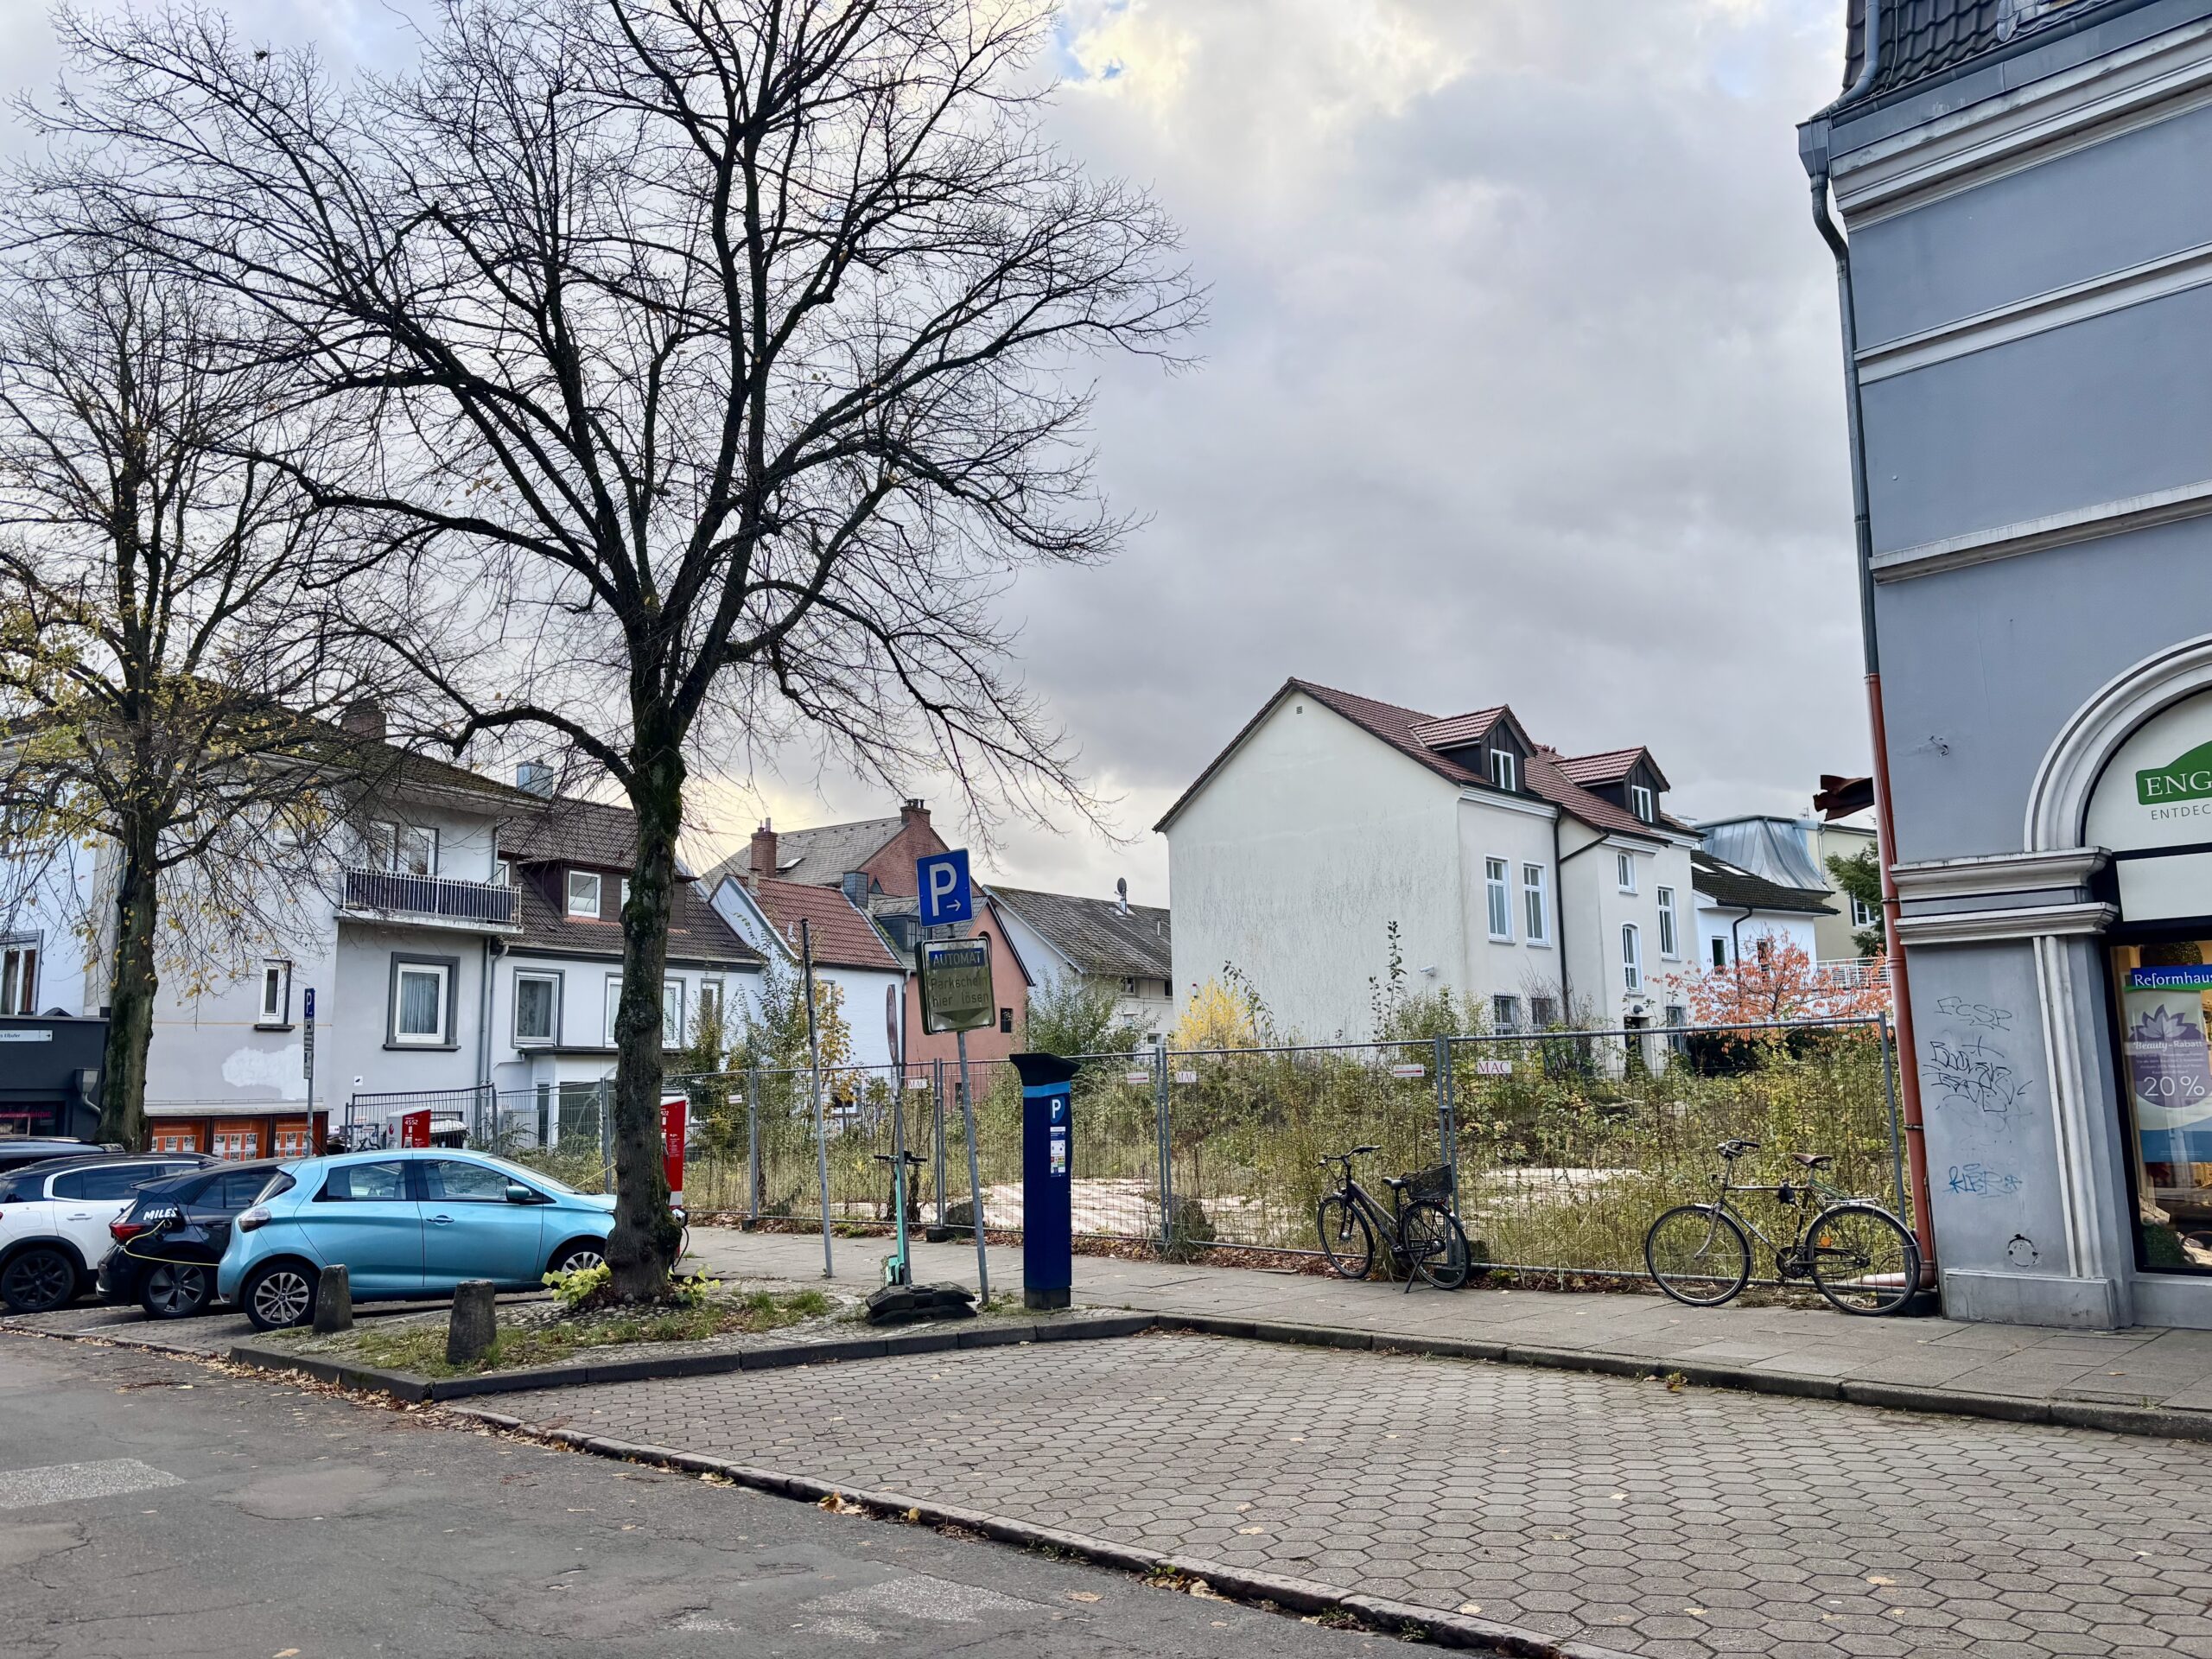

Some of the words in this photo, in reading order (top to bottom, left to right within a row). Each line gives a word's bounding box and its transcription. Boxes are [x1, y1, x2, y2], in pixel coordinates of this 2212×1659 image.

[2152, 804, 2211, 820] ENTDEC
[930, 862, 957, 917] P
[933, 950, 982, 968] AUTOMAT
[931, 976, 988, 990] Parkschein
[932, 995, 953, 1007] hier
[962, 992, 988, 1005] lösen
[1478, 1061, 1509, 1073] MAC
[1052, 1099, 1061, 1118] P
[143, 1207, 178, 1220] MILES
